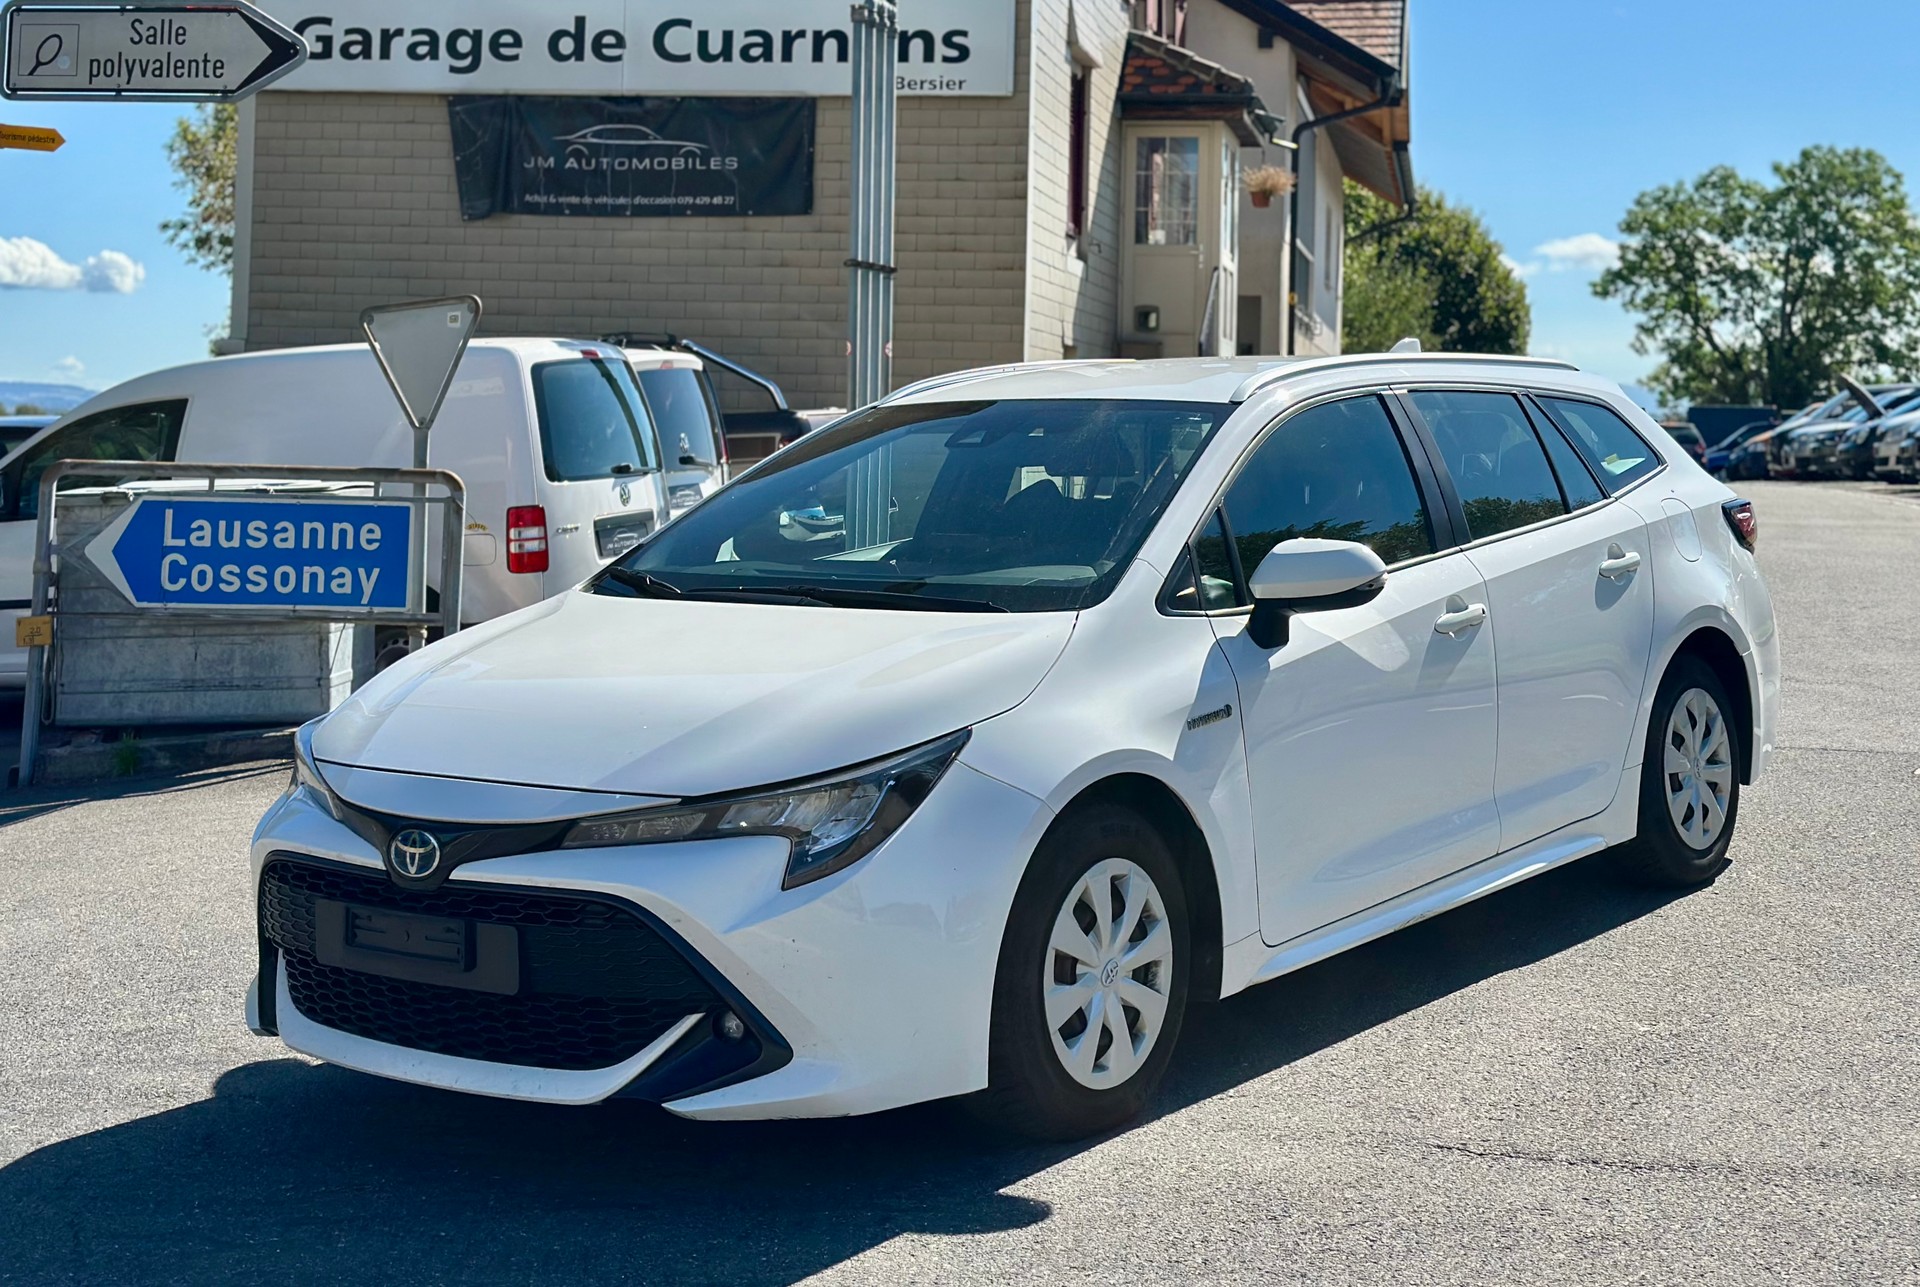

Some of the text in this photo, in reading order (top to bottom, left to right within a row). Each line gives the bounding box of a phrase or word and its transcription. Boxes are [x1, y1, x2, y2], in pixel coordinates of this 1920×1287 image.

[129, 18, 187, 46] Salle
[293, 15, 971, 75] Garage de Cuarnns
[88, 51, 225, 85] polyvalente
[895, 75, 967, 91] Bersier
[523, 156, 739, 170] JM AUTOMOBILES
[557, 196, 581, 205] vente
[581, 195, 593, 205] de
[593, 194, 632, 205] véhicules
[632, 194, 676, 206] d'occasion
[163, 508, 382, 551] Lausanne
[160, 553, 381, 605] Cossonay
